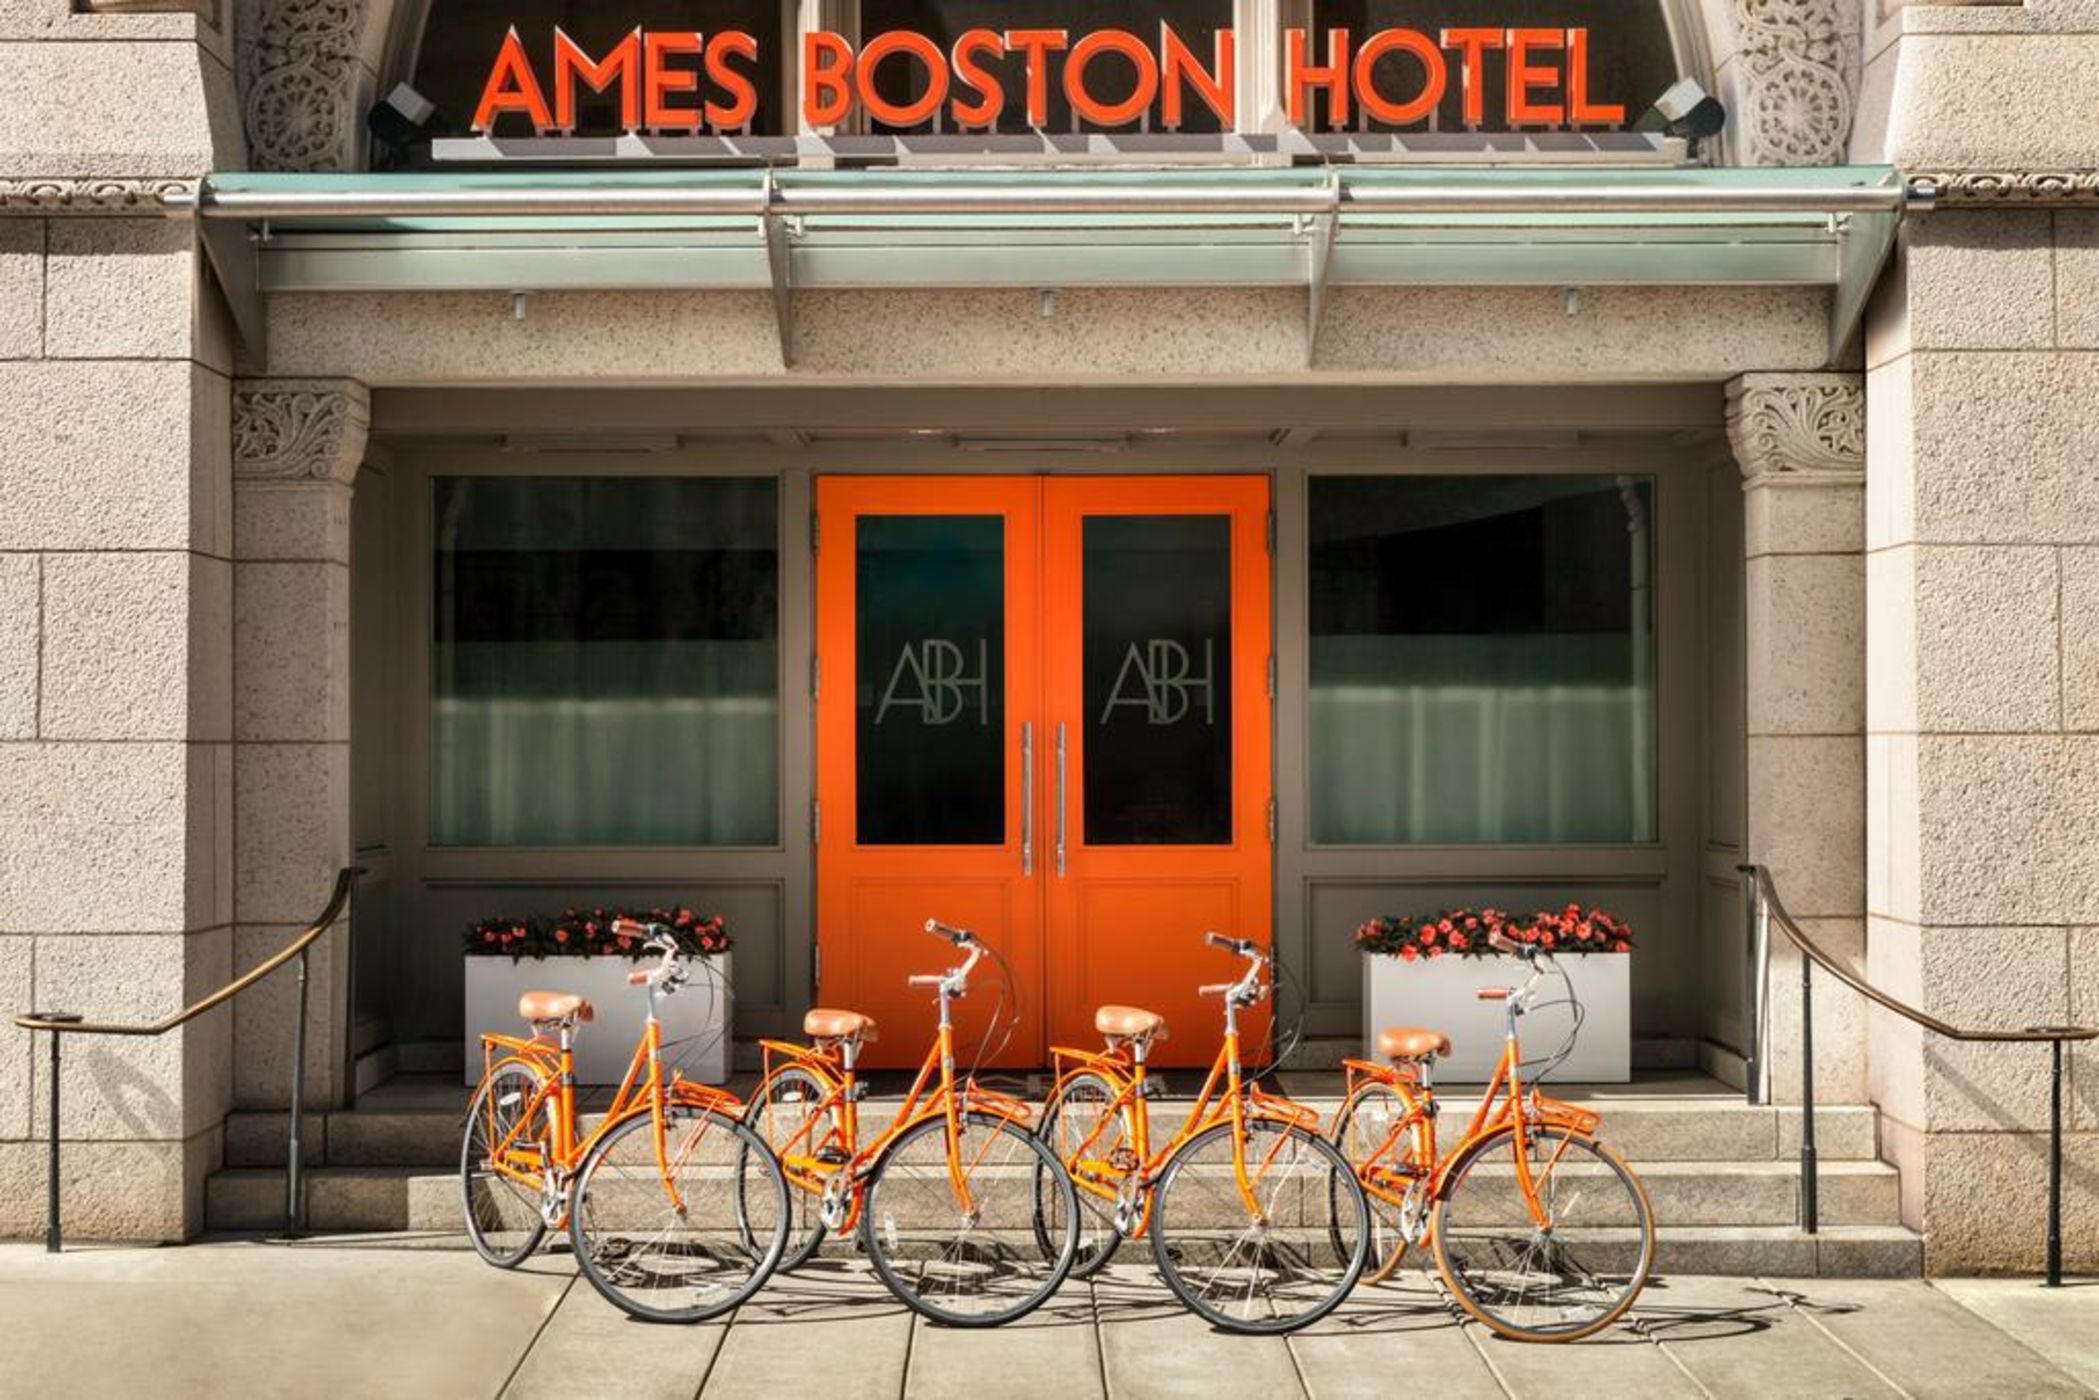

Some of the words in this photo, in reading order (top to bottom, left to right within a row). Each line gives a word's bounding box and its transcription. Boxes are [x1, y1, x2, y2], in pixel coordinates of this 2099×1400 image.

[471, 25, 757, 133] AMES
[803, 20, 1234, 130] BOSTON
[1285, 27, 1625, 126] HOTEL
[873, 638, 988, 726] ABH
[1100, 638, 1214, 726] ABH
